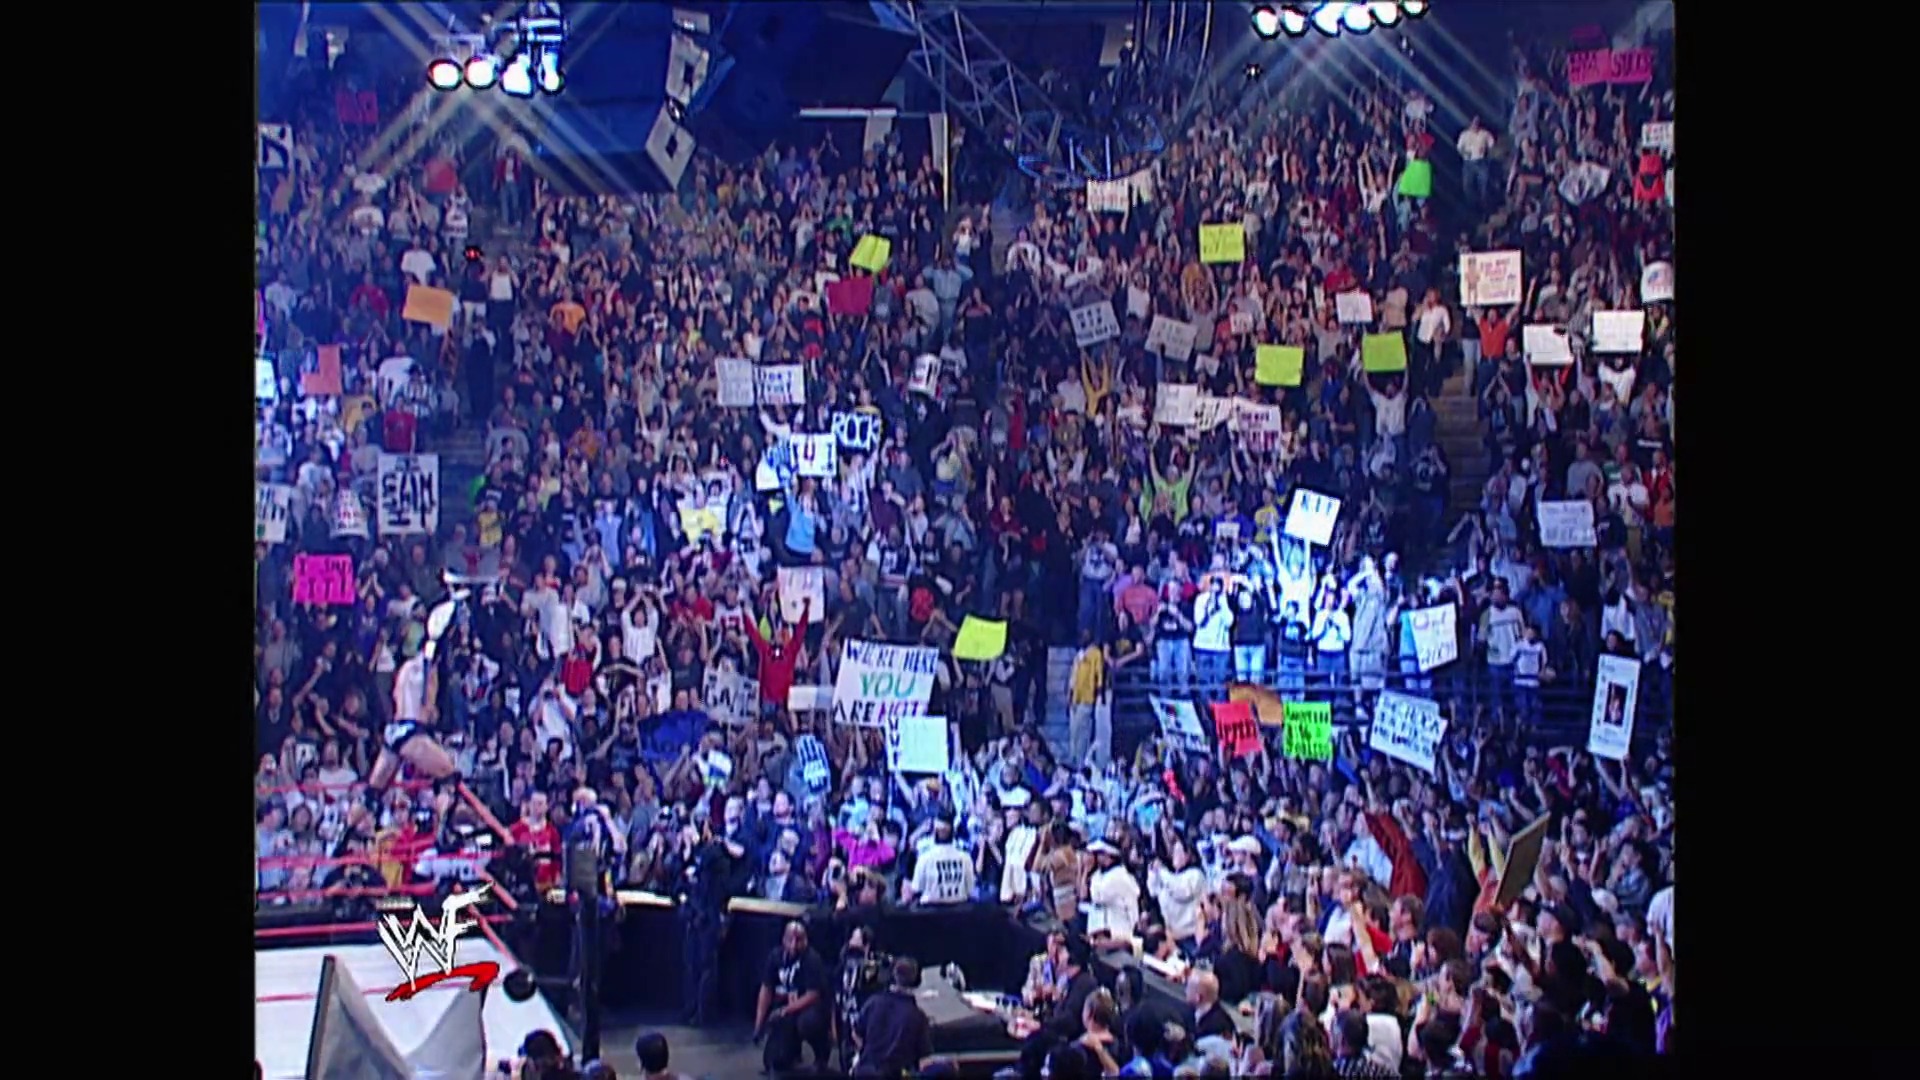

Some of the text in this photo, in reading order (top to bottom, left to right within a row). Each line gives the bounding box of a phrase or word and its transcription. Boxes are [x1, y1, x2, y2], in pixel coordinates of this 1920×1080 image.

[831, 411, 881, 452] ROCK
[861, 671, 916, 698] YOU
[834, 699, 876, 721] ARE
